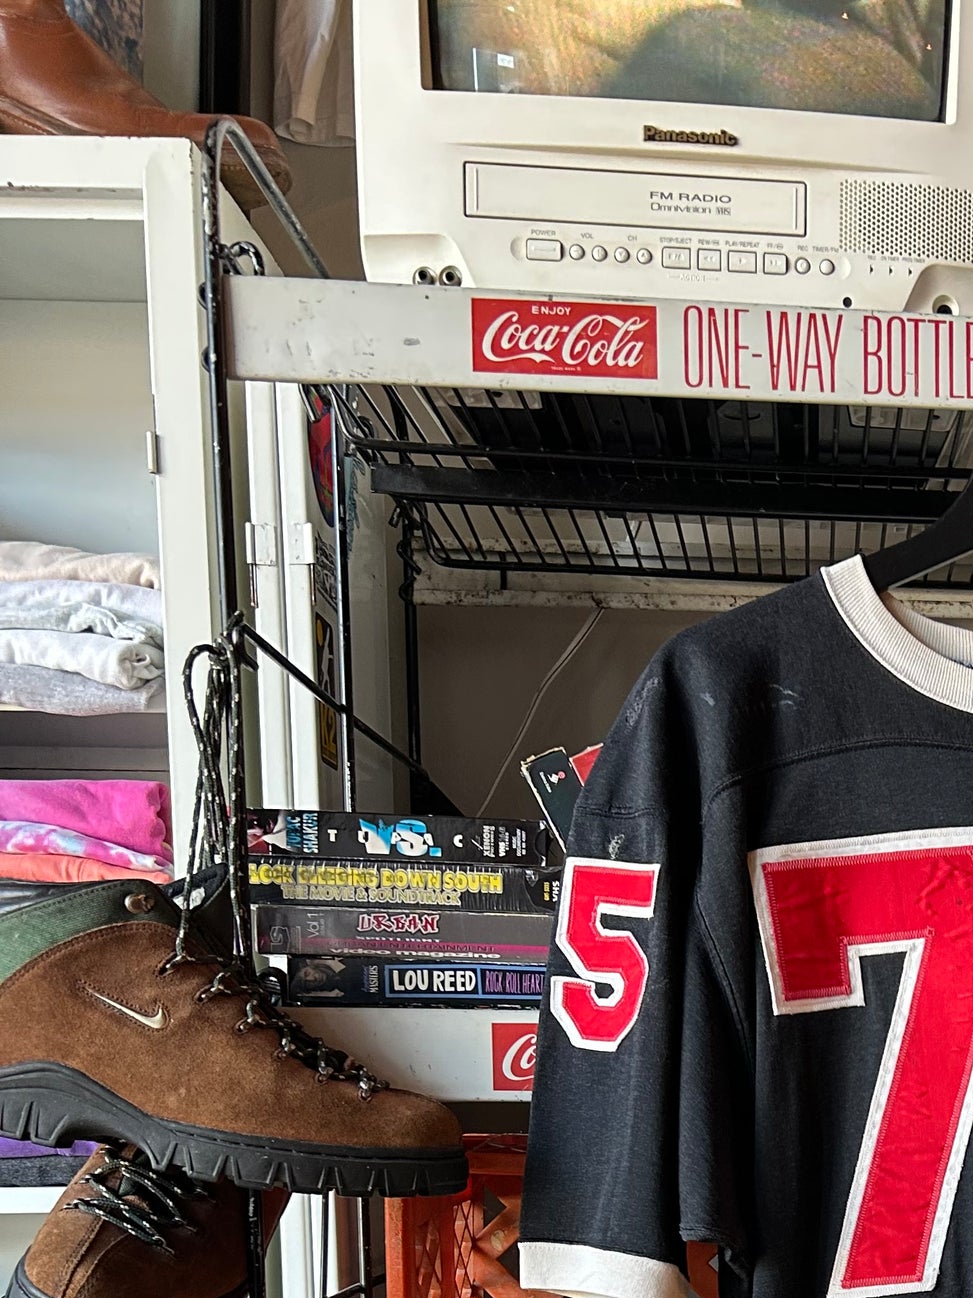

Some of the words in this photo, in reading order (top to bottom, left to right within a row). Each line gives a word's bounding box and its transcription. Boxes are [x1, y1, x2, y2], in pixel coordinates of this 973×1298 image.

[643, 124, 739, 147] Panasonic
[650, 191, 673, 201] FM
[679, 192, 732, 204] RADIO
[650, 202, 711, 214] Omnivision
[530, 228, 557, 237] POWER
[581, 232, 594, 240] VOL
[627, 234, 638, 242] CH
[531, 305, 572, 316] ENJOY
[482, 311, 649, 368] Coca-Cola
[683, 305, 843, 393] ONE-WAY
[302, 812, 319, 854] SHAKUR
[483, 825, 491, 857] XENON
[498, 842, 506, 857] VHS
[297, 864, 379, 888] BLEEDING
[380, 868, 441, 889] DOWN
[443, 870, 503, 894] SOUTH
[281, 884, 308, 899] THE
[310, 886, 355, 901] MOVIE
[356, 888, 368, 902] &
[368, 888, 461, 907] SOUNDTRACK
[552, 881, 560, 902] VHS
[306, 921, 320, 938] Vol
[356, 912, 440, 934] URBAN
[329, 948, 391, 956] video
[396, 949, 501, 960] magazine
[550, 857, 660, 1051] 5
[392, 970, 429, 991] LOU
[433, 970, 476, 991] REED
[485, 970, 503, 993] ROCK
[505, 972, 521, 993] ROLL
[522, 973, 544, 993] HEART
